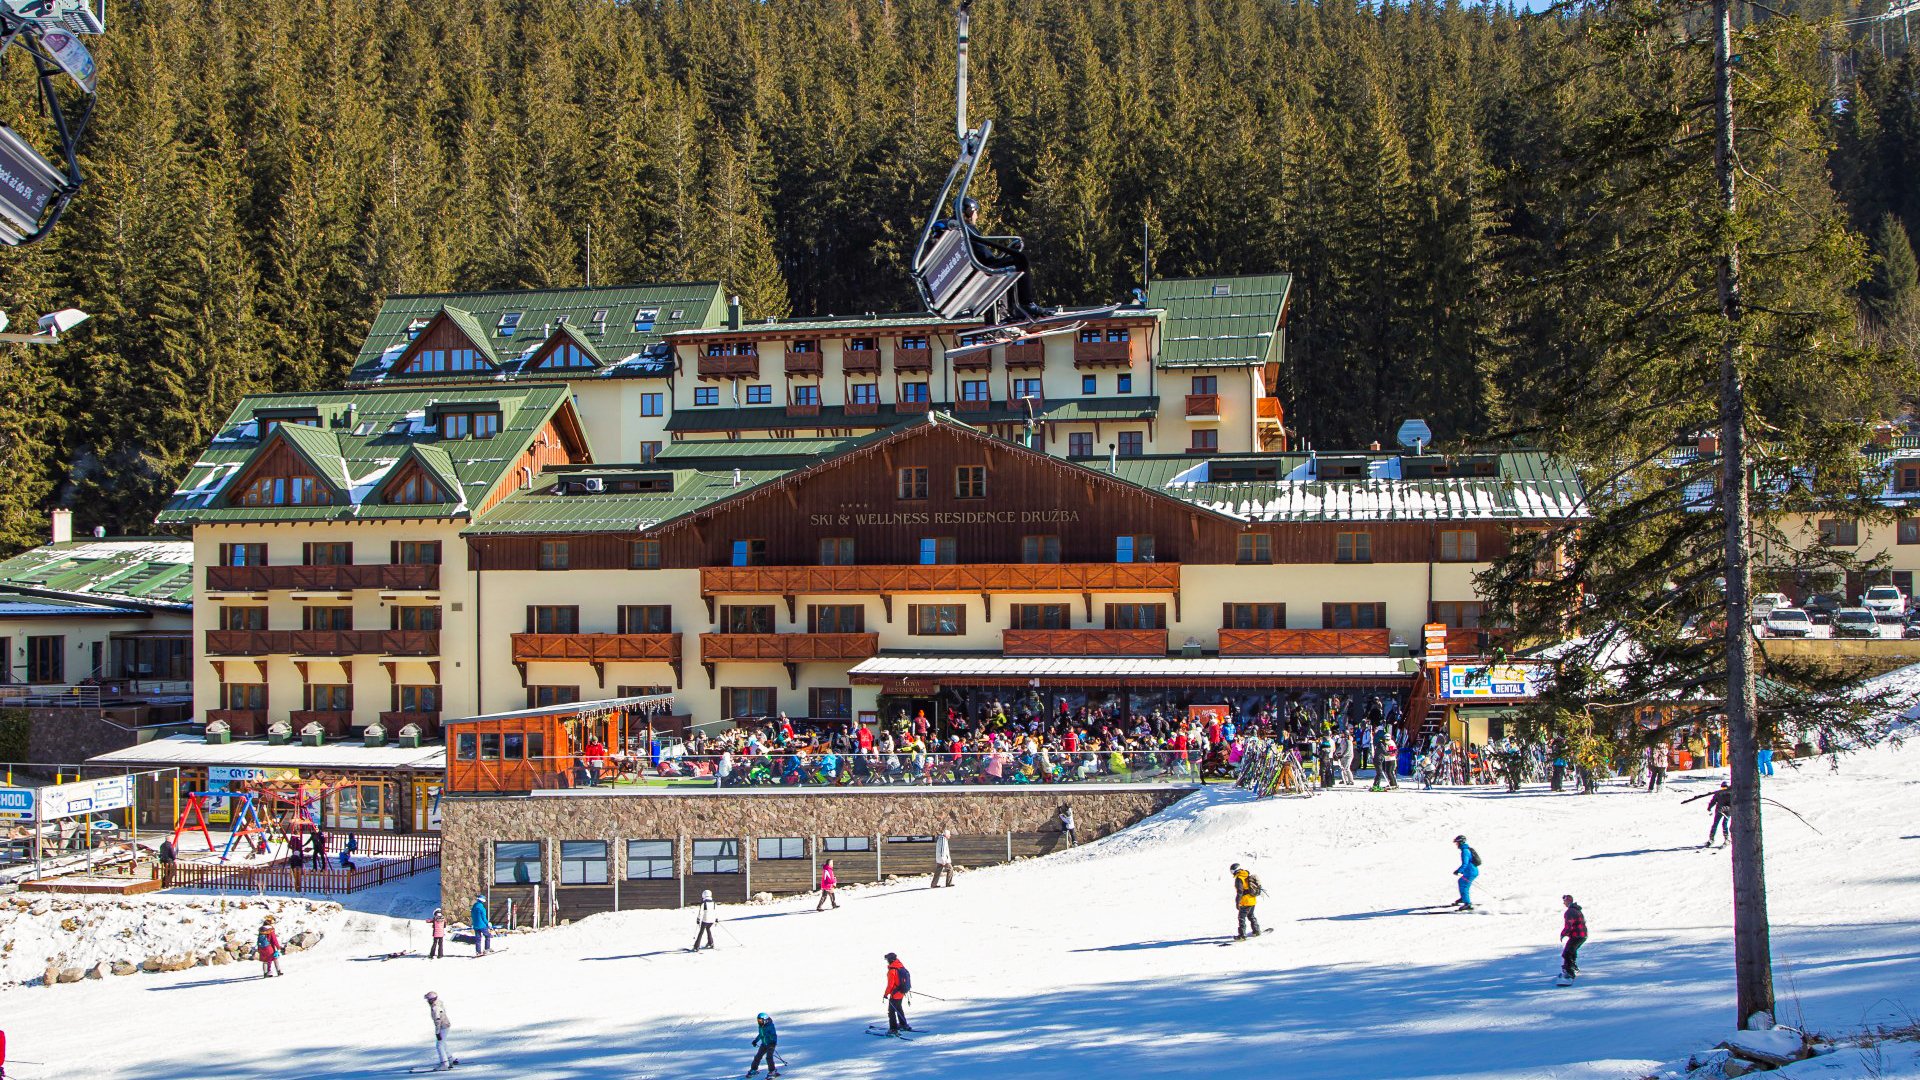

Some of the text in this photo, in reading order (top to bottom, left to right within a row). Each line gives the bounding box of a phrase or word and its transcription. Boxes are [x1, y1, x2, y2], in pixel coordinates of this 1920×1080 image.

[810, 508, 1080, 526] SKI & WELLNESS RESIDENCE DRUŽBA
[1495, 684, 1521, 693] RENTAL
[0, 793, 27, 807] HOOL
